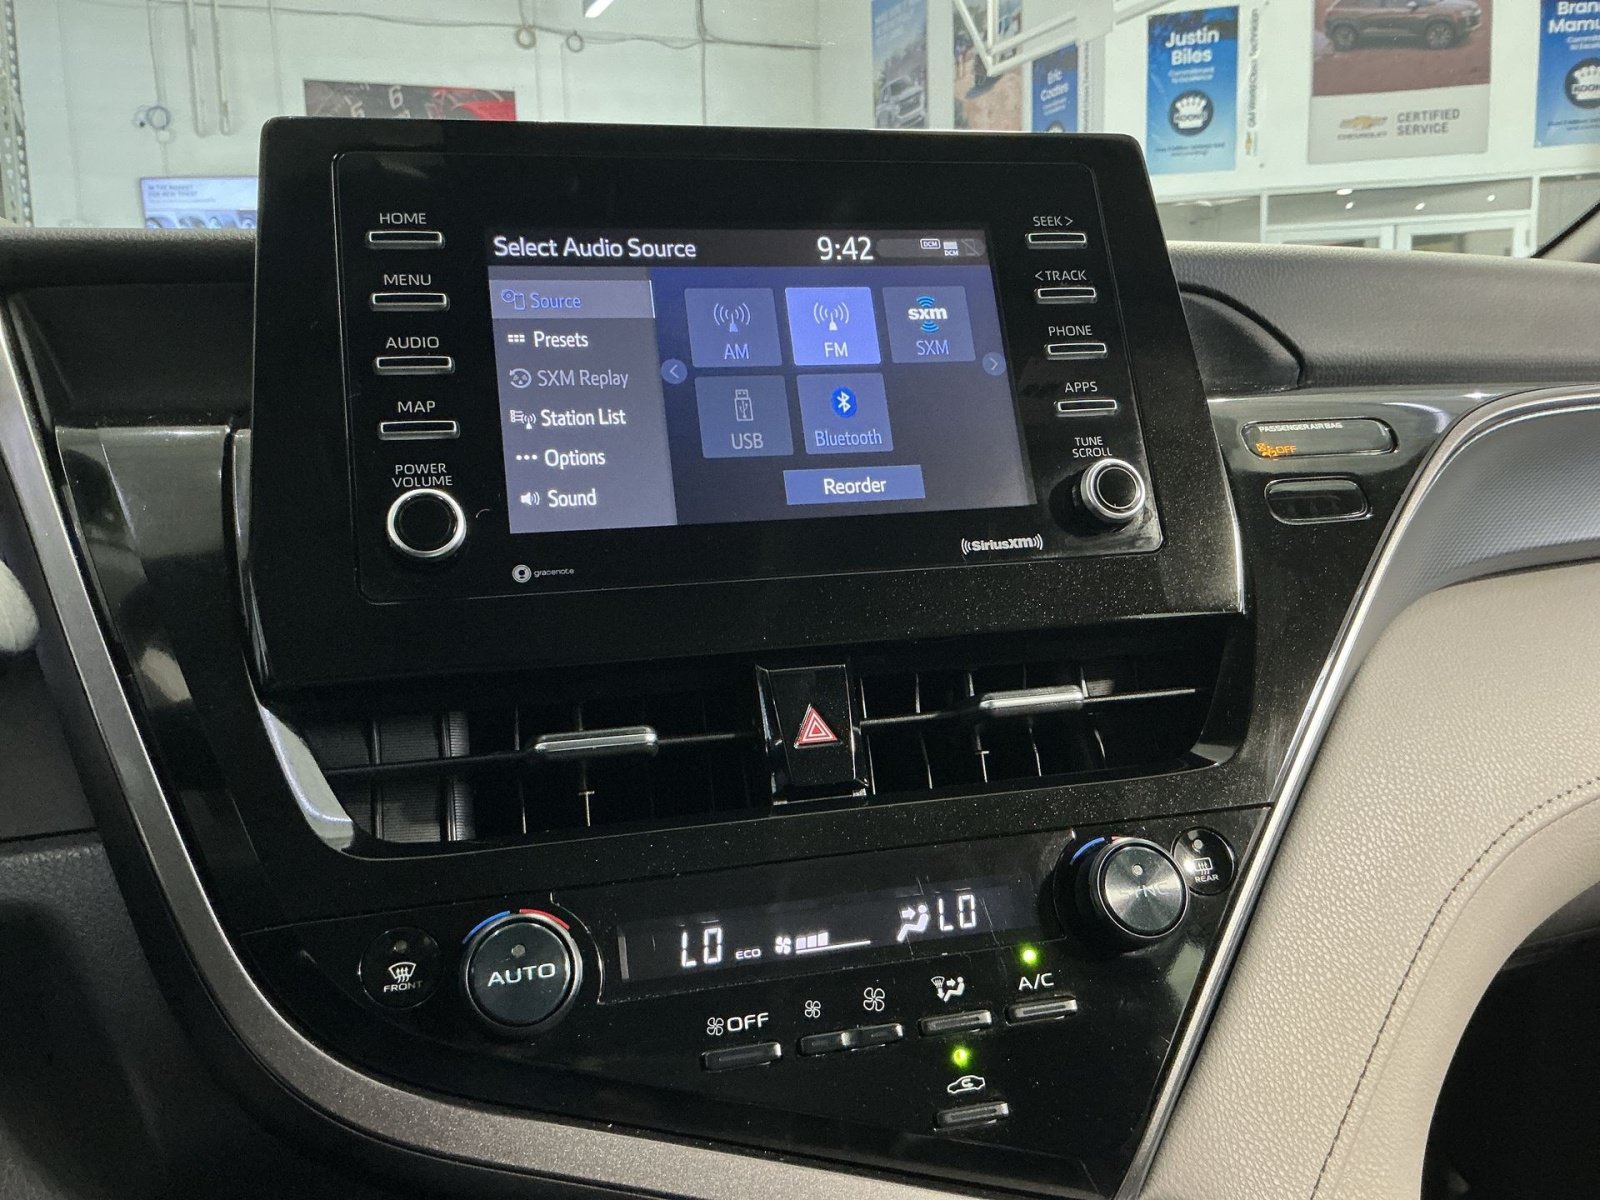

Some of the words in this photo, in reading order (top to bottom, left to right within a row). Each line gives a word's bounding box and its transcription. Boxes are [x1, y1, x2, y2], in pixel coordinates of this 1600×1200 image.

[1165, 26, 1220, 48] Justin
[1171, 48, 1213, 66] Biles
[1397, 108, 1461, 123] CERTIFIED
[1397, 122, 1449, 136] SERVICE
[379, 212, 427, 225] HOME
[1032, 216, 1063, 227] SEEK
[493, 235, 558, 257] Select
[563, 237, 624, 257] Audio
[627, 238, 697, 257] Source
[817, 236, 874, 260] 9:42
[944, 249, 959, 257] DCM
[383, 274, 432, 286] MENU
[1045, 270, 1087, 281] TRACK
[530, 292, 582, 309] Source
[908, 306, 948, 320] sxm
[1048, 325, 1093, 336] PHONE
[385, 336, 440, 349] AUDIO
[533, 331, 589, 347] Presets
[724, 344, 750, 360] AM
[824, 341, 848, 358] FM
[915, 340, 950, 356] SXM
[537, 370, 575, 386] SXM
[579, 369, 629, 389] Replay
[1064, 381, 1098, 393] APPS
[397, 401, 436, 413] MAP
[540, 409, 595, 427] Station
[598, 408, 627, 425] List
[1258, 423, 1309, 432] PASSENGER
[1310, 422, 1324, 430] AIR
[1324, 421, 1344, 430] BAG
[731, 432, 764, 450] USB
[814, 429, 883, 447] Bluetooth
[1074, 436, 1104, 446] TUNE
[1072, 447, 1113, 458] SCROLL
[1275, 445, 1297, 454] OFF
[544, 449, 606, 470] Options
[395, 463, 447, 475] POWER
[392, 475, 453, 488] VOLUME
[823, 477, 887, 495] Reorder
[547, 488, 597, 508] Sound
[533, 568, 575, 578] gracenote
[1194, 874, 1220, 883] REAR
[735, 948, 761, 960] ECO
[487, 962, 556, 987] AUTO
[1018, 972, 1054, 990] A/C
[383, 980, 423, 993] FRONT
[726, 1012, 769, 1032] OFF
